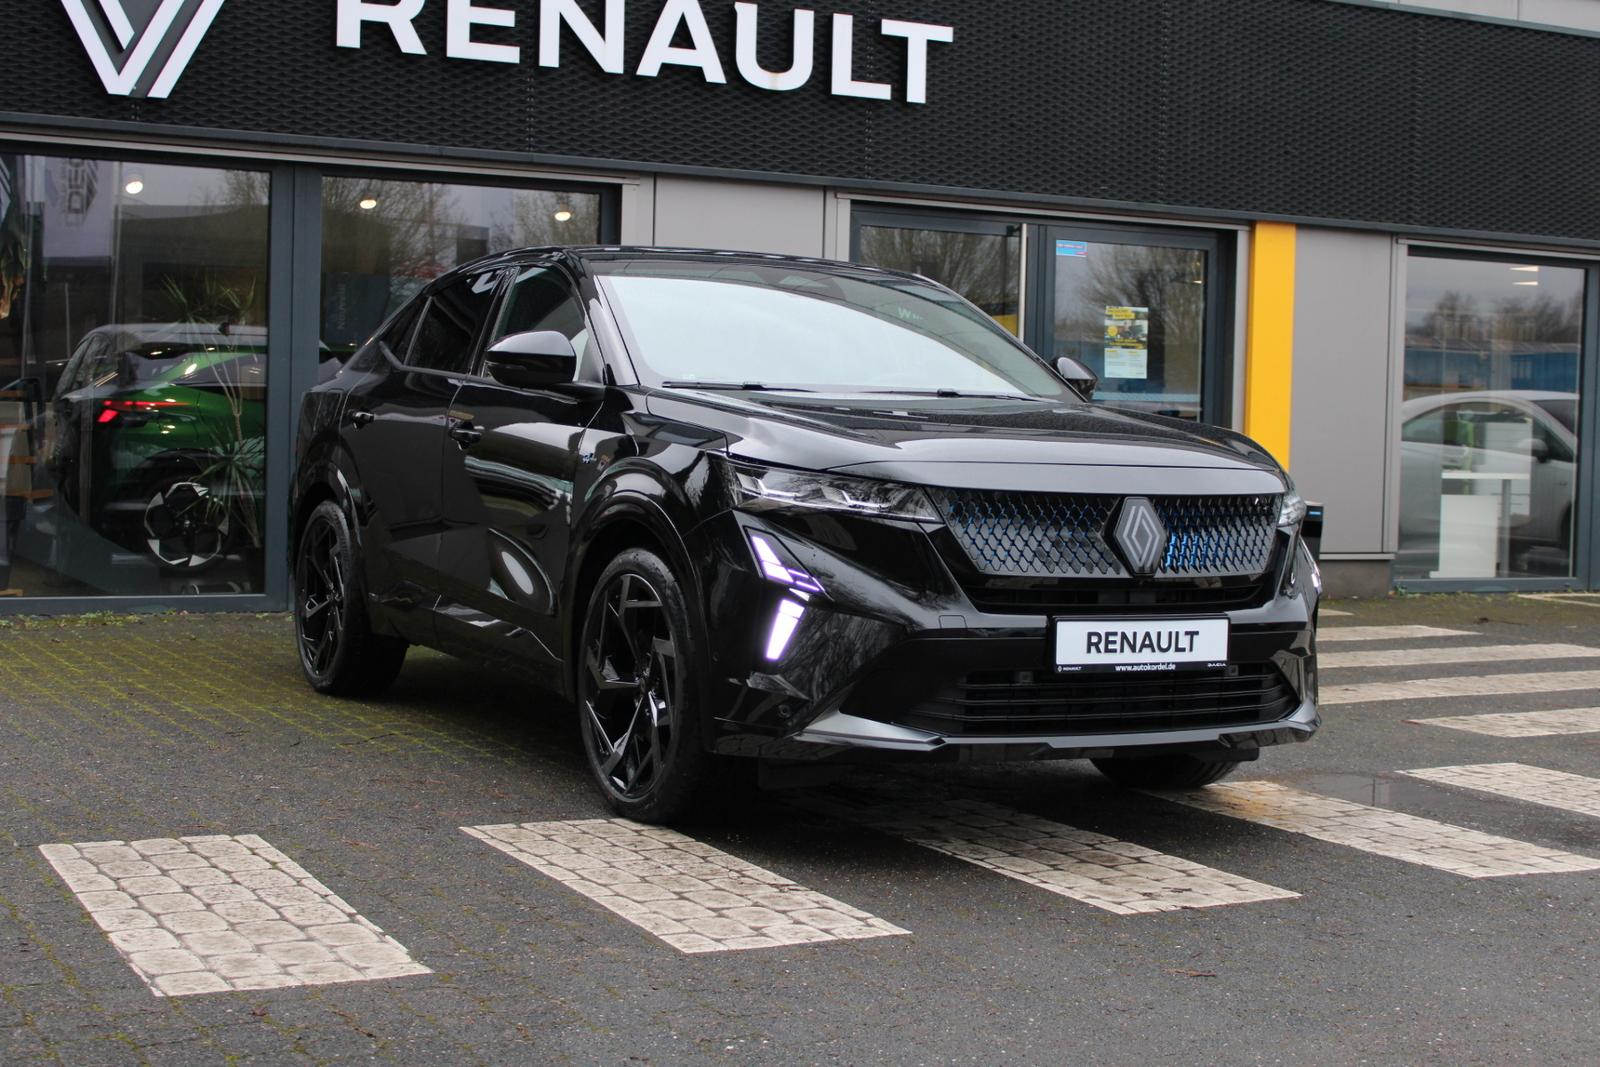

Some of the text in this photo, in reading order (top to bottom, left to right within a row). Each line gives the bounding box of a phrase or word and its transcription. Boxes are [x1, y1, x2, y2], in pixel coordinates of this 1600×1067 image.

[336, 0, 954, 105] RENAULT
[1086, 630, 1200, 654] RENAULT
[1115, 662, 1176, 672] www.autokordel.de
